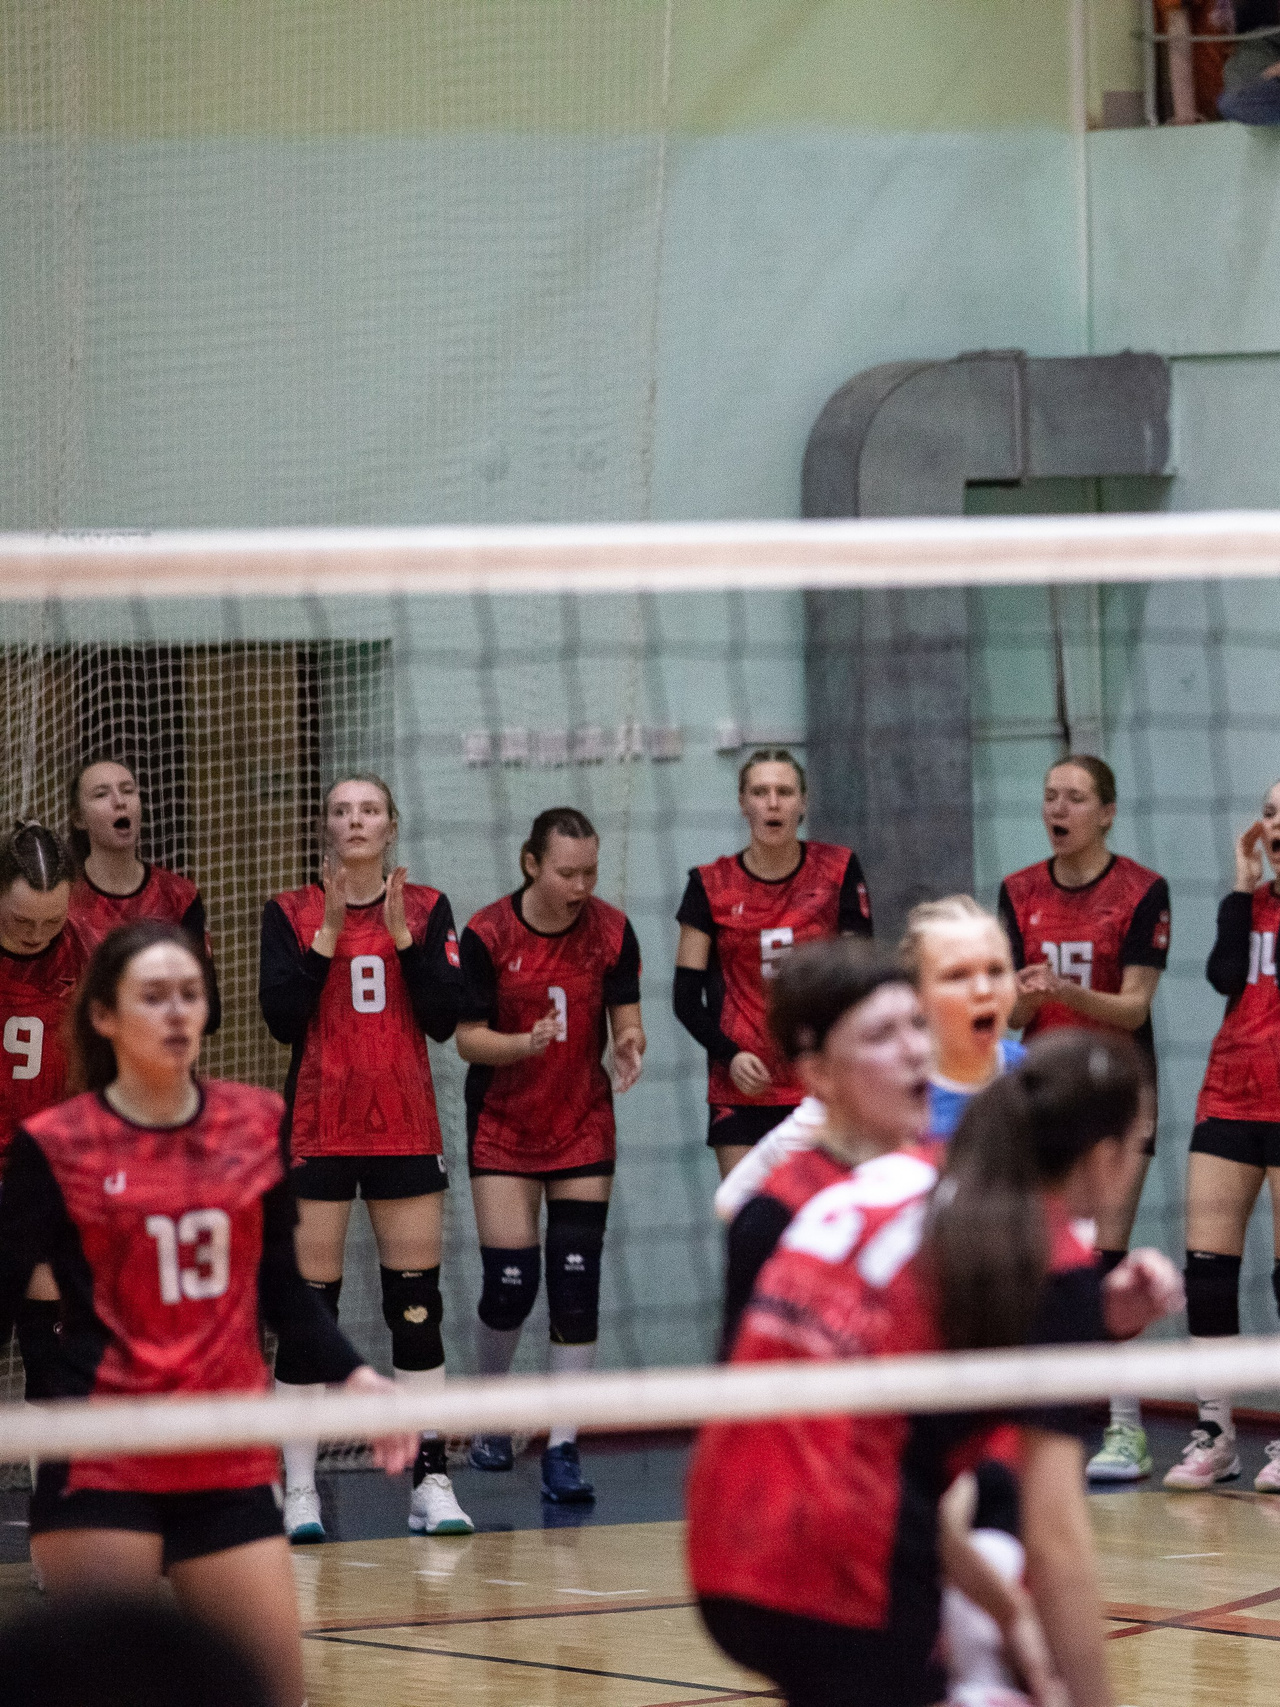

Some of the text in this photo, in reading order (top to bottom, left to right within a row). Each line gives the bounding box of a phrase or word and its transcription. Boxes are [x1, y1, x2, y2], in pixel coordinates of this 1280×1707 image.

[350, 954, 386, 1014] 8
[1041, 940, 1093, 992] 15
[547, 985, 568, 1043] 1
[3, 1015, 45, 1080] 9
[145, 1207, 231, 1306] 13
